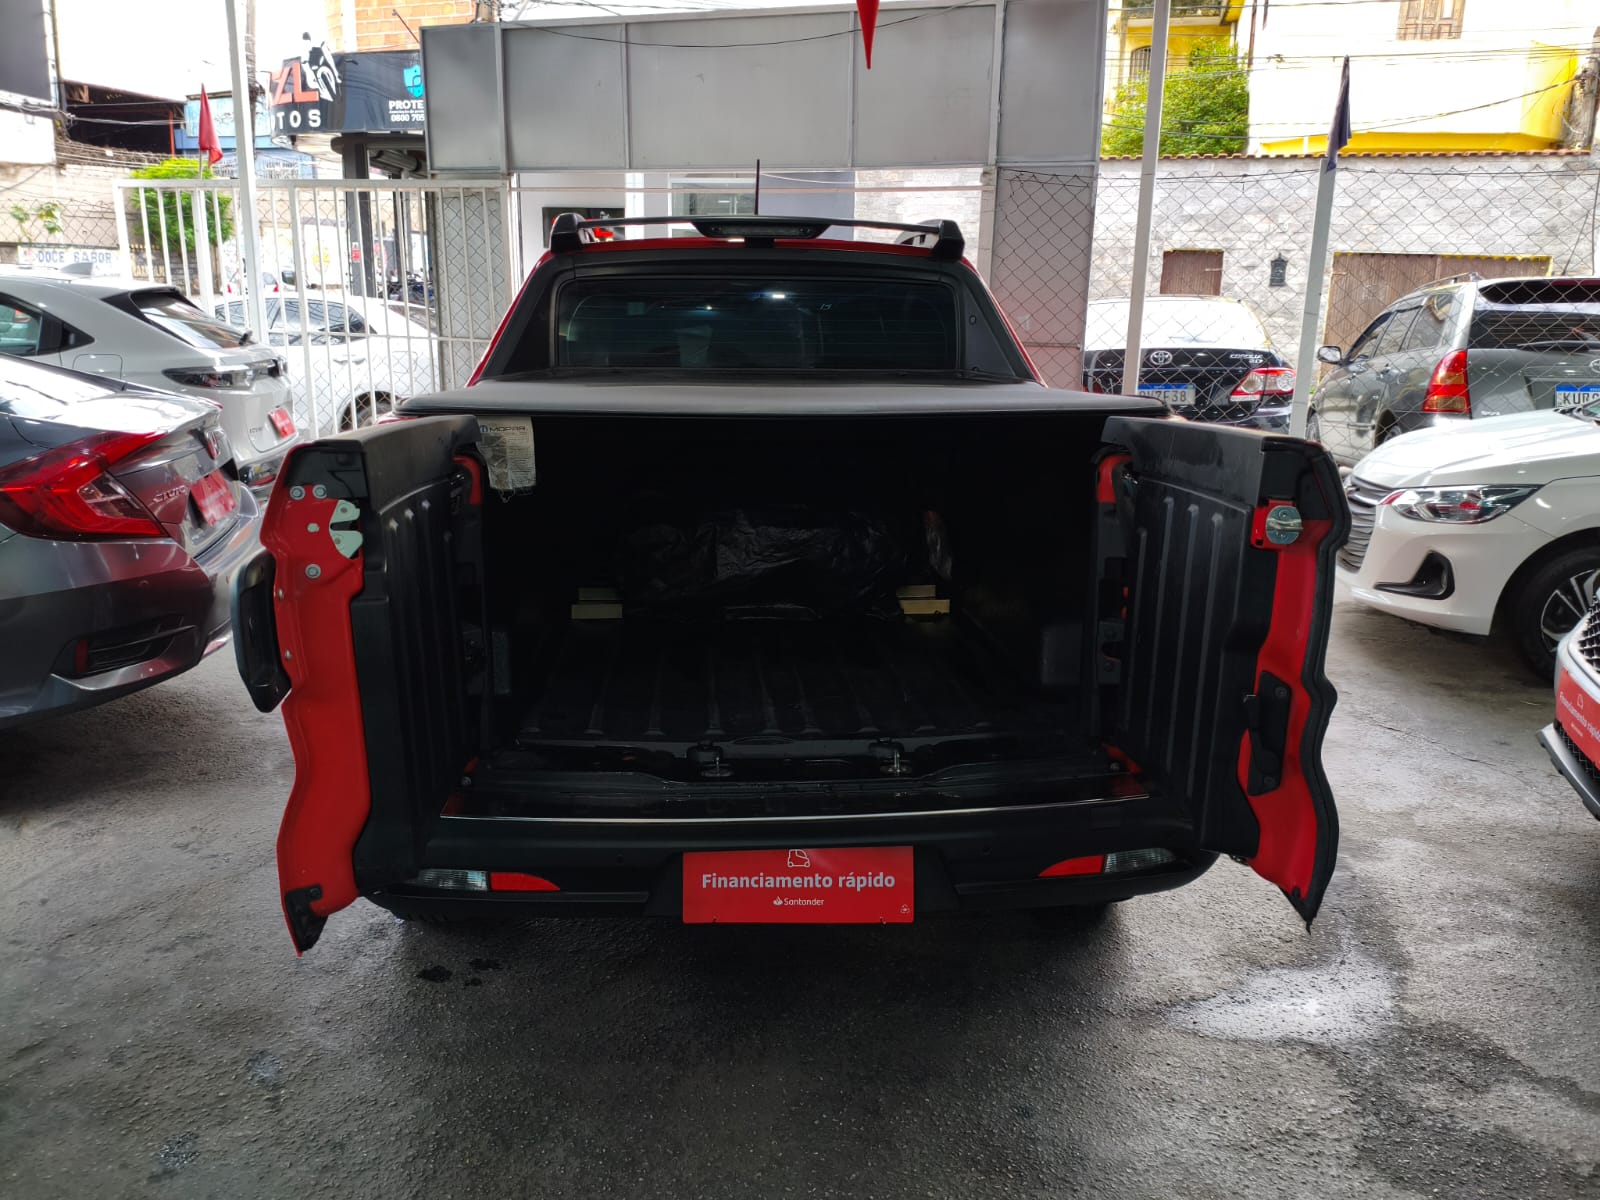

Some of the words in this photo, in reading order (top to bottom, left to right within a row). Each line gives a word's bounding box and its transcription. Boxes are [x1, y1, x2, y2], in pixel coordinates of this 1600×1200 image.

[389, 100, 424, 109] PROTE
[702, 872, 833, 889] Financiamento
[838, 872, 896, 892] rápido
[783, 897, 825, 906] Santander
